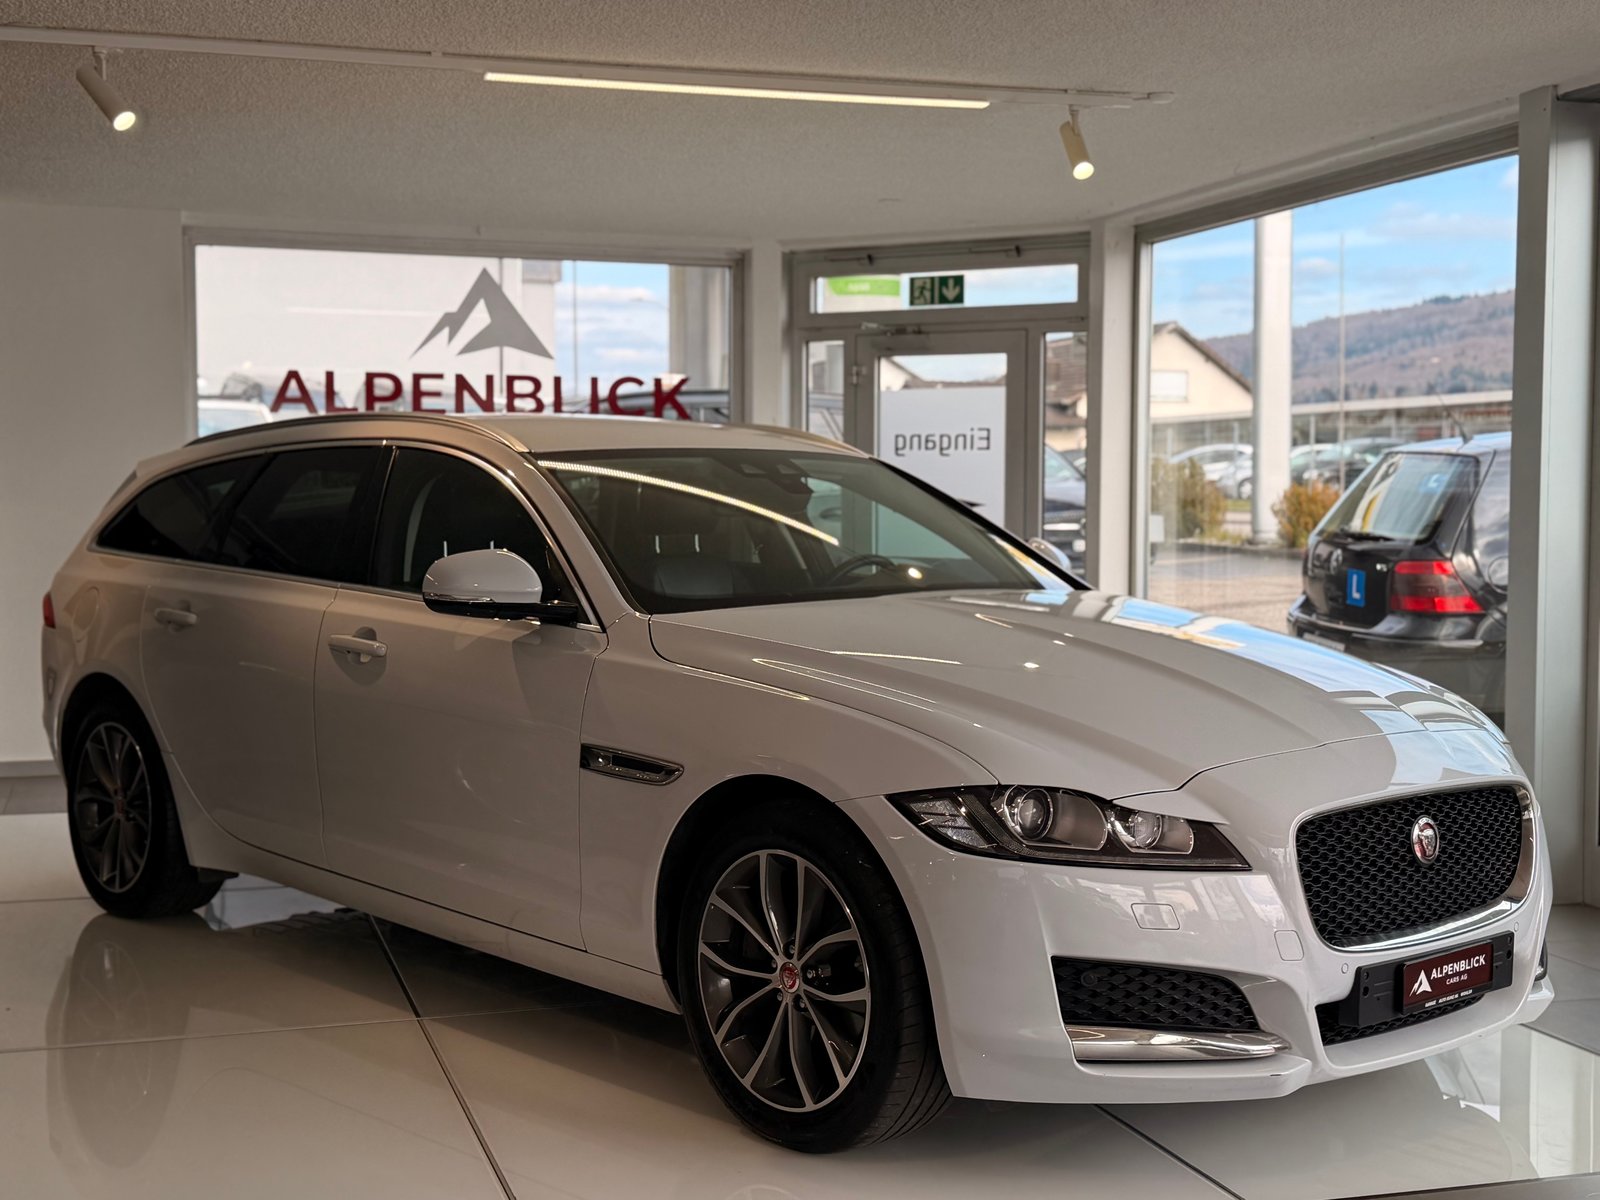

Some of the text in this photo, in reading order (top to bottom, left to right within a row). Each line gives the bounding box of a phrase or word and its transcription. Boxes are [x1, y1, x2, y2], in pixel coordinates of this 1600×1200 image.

[270, 370, 692, 420] ALPENBLICK
[1352, 573, 1361, 600] L
[1430, 954, 1486, 980] ALPENBLICK
[1446, 976, 1460, 985] CARS
